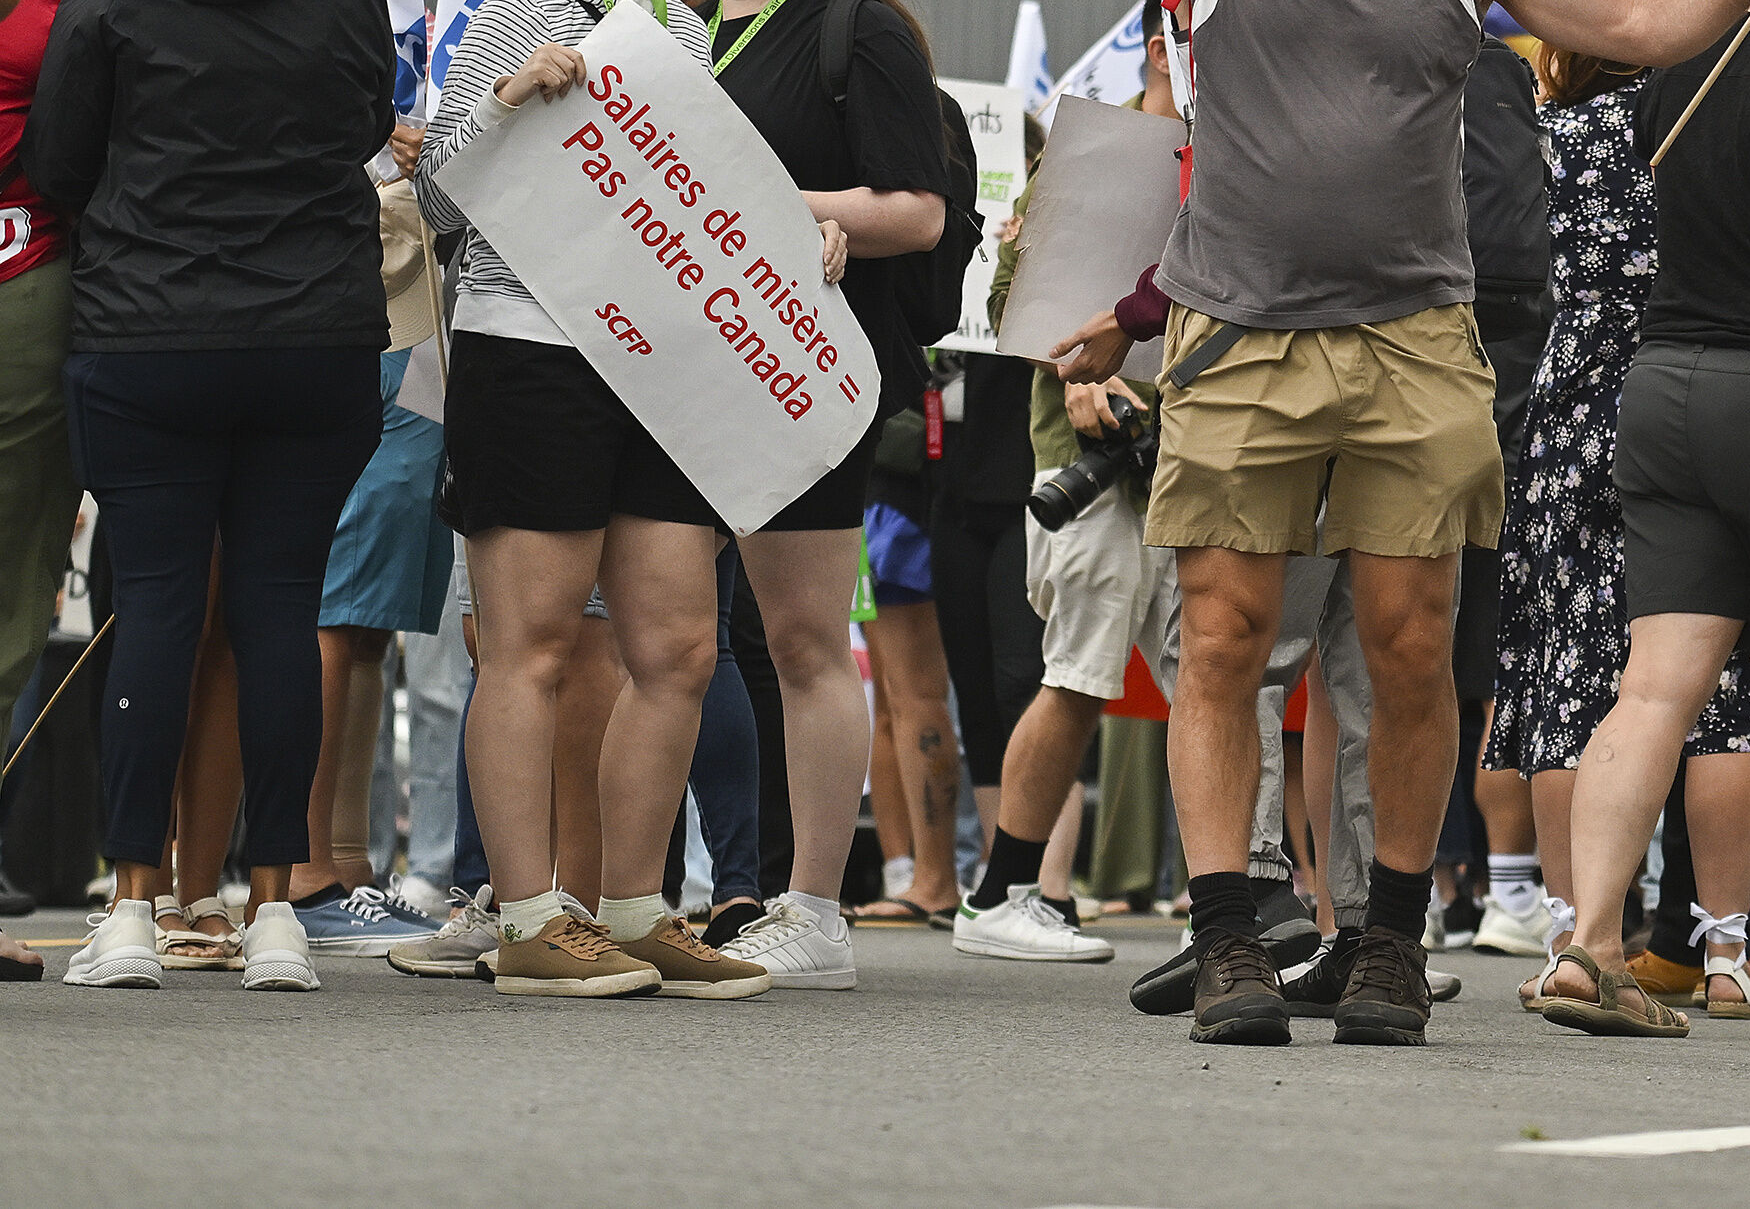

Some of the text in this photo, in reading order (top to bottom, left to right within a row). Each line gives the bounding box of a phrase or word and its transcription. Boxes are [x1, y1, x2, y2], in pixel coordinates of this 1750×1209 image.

[561, 120, 813, 422] Pas notre Canada
[587, 64, 706, 208] Salaires
[702, 210, 747, 258] de
[742, 256, 838, 373] misère
[594, 302, 653, 357] SCFP
